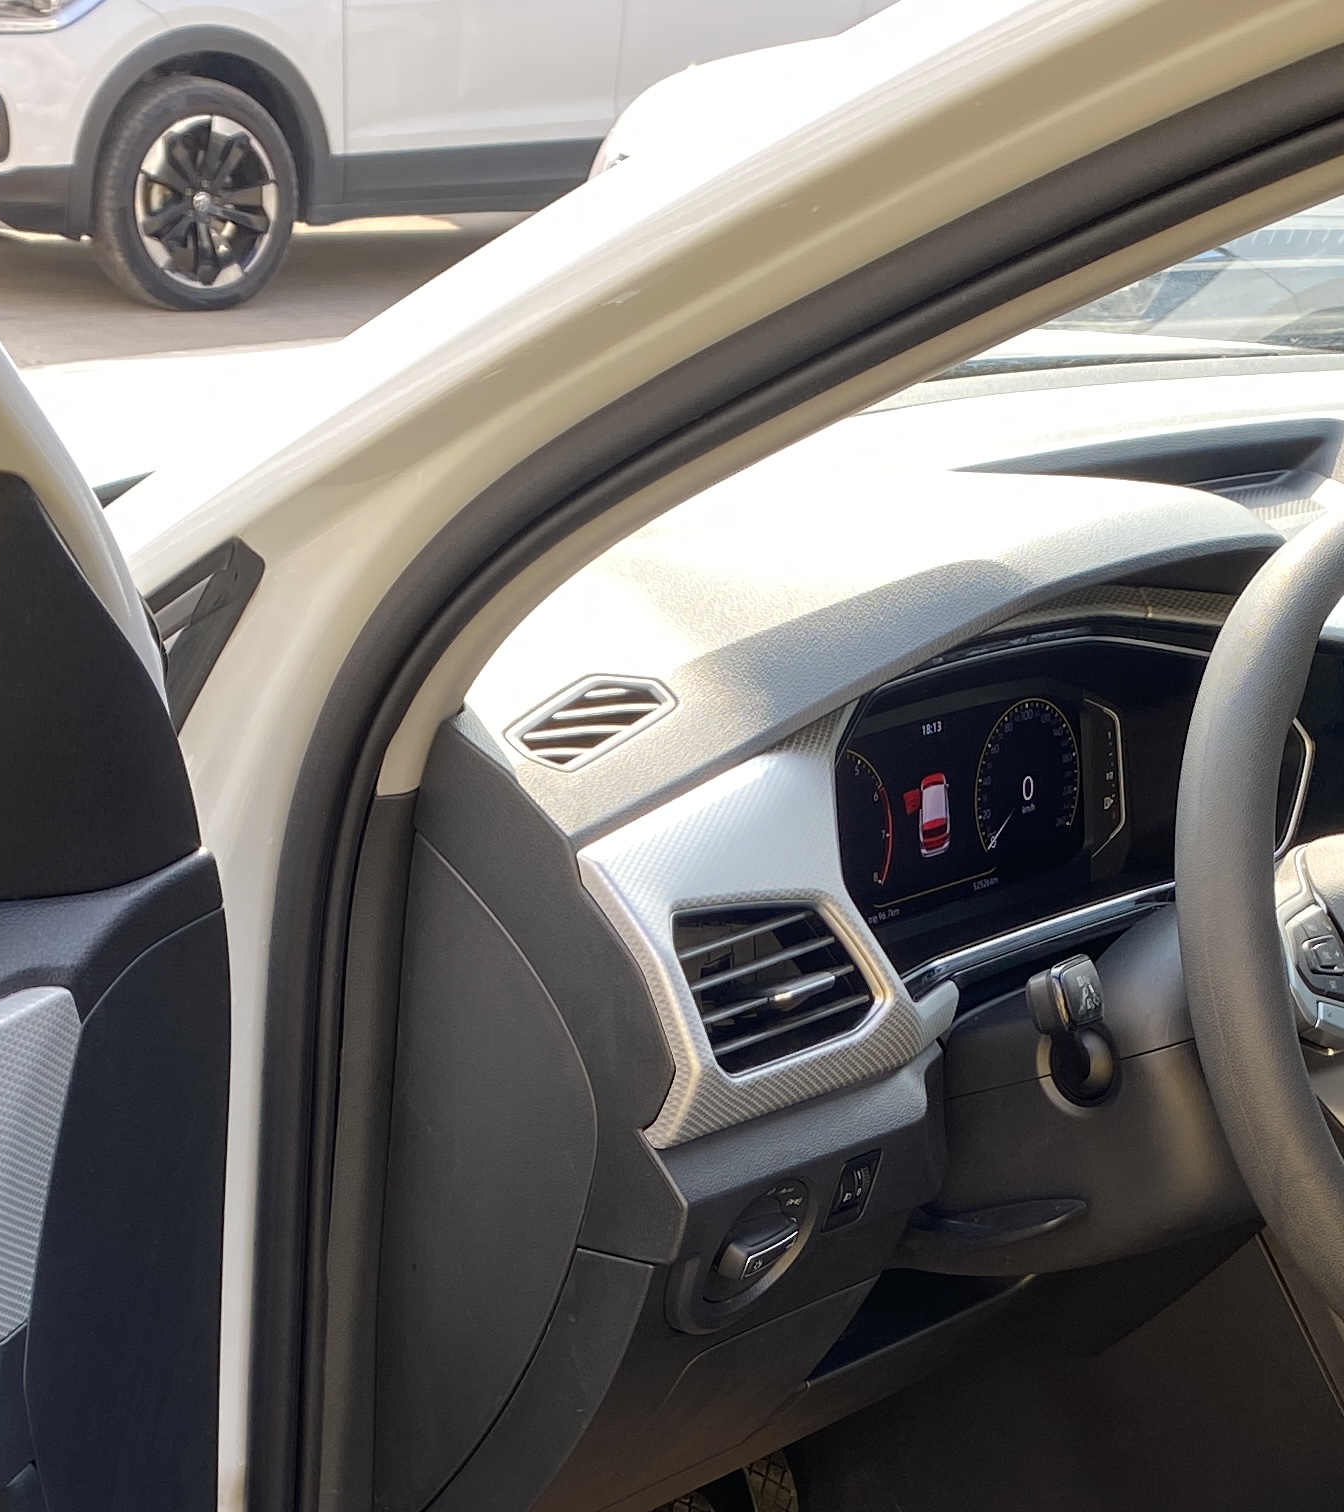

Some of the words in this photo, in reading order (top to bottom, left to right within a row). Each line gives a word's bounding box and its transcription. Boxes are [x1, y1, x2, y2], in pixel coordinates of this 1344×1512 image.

[1020, 709, 1034, 721] 100
[921, 721, 942, 735] 18:13
[1022, 775, 1034, 801] 0
[982, 808, 991, 820] 20
